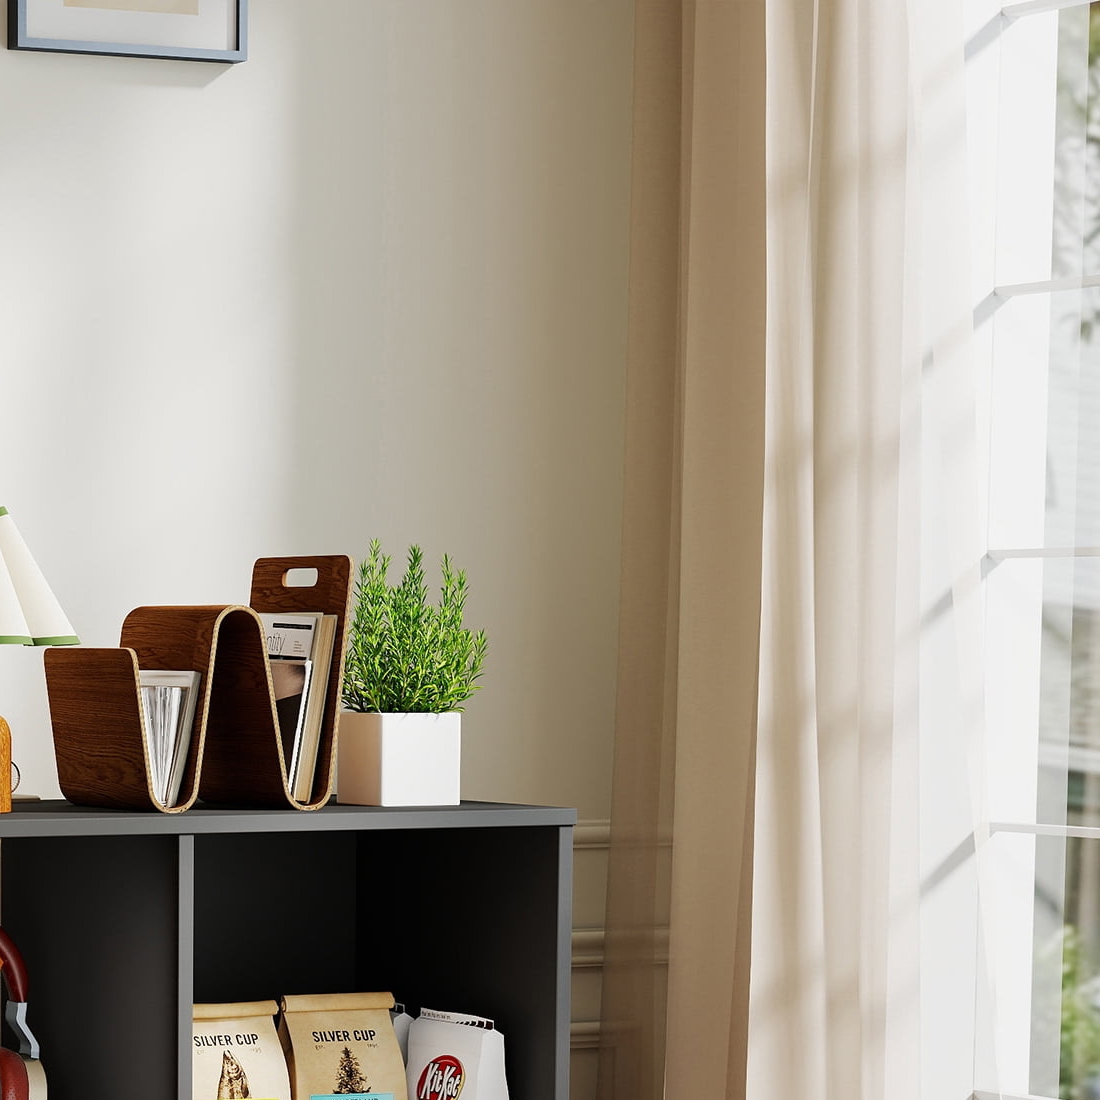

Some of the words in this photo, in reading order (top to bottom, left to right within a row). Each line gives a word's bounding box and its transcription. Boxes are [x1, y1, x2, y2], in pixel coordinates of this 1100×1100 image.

[193, 1035, 233, 1047] SILVER
[235, 1033, 259, 1046] CUP
[312, 1030, 351, 1043] SILVER
[353, 1029, 376, 1041] CUP
